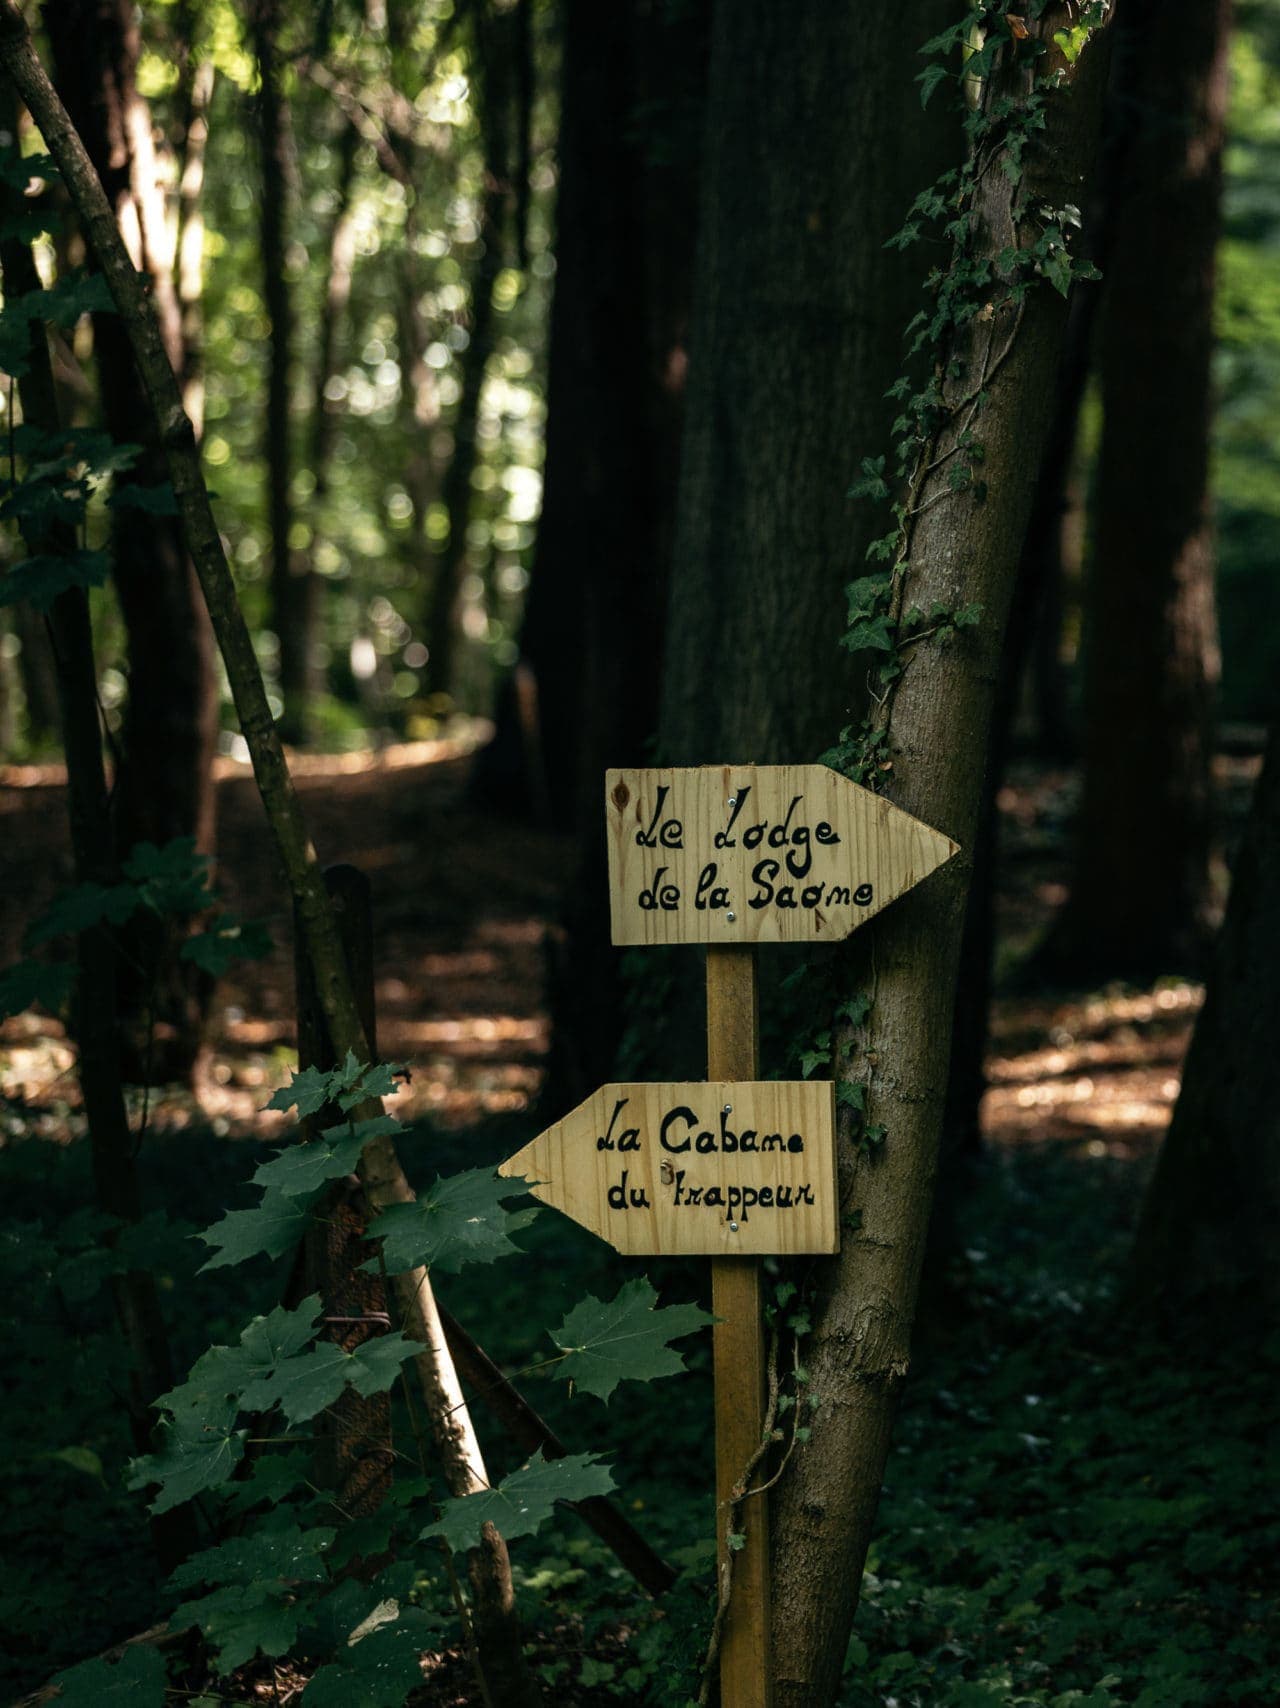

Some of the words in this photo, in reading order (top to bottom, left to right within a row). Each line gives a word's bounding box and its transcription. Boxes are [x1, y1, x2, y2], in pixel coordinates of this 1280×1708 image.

[635, 785, 684, 849] Le
[714, 785, 842, 879] Lodge
[637, 866, 681, 911] de
[694, 862, 731, 910] la
[596, 1098, 641, 1152] La
[659, 1105, 805, 1154] Cabane
[607, 1169, 651, 1210] du
